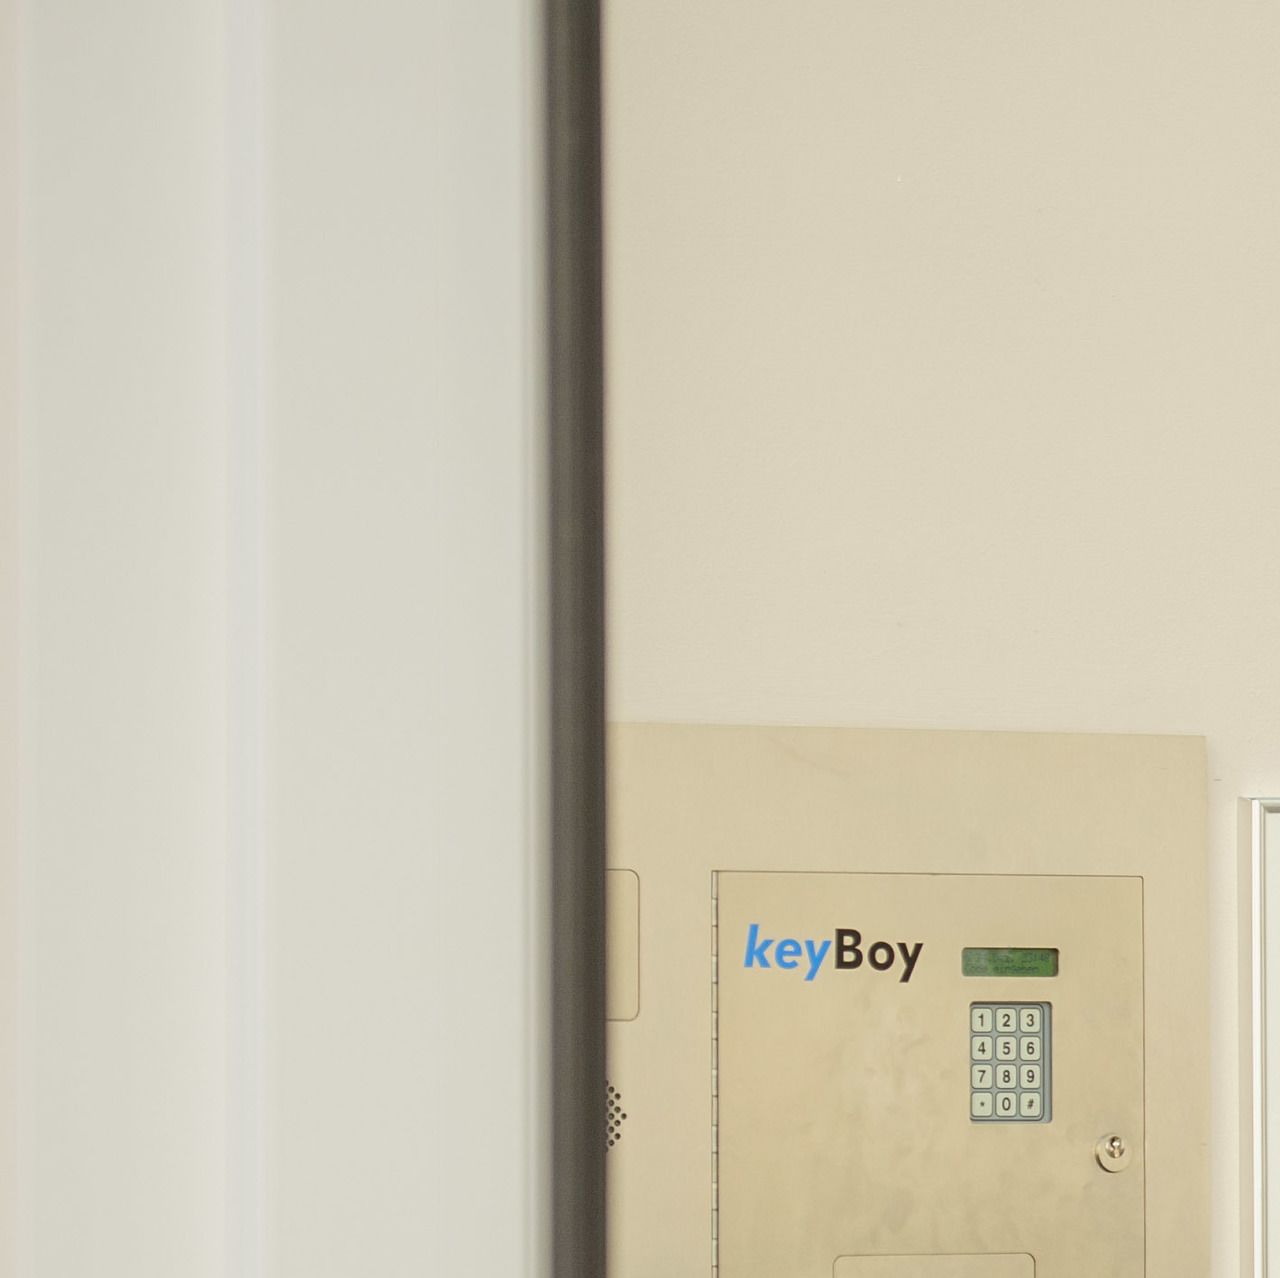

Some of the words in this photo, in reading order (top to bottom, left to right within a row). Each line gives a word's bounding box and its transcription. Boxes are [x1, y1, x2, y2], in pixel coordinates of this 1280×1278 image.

[745, 924, 924, 983] keyBoy
[978, 1013, 984, 1028] 1
[1002, 1013, 1011, 1028] 2
[1026, 1013, 1035, 1028] 3
[977, 1041, 987, 1055] 4
[1002, 1041, 1011, 1056] 5
[1026, 1041, 1035, 1056] 6
[977, 1069, 987, 1084] 7
[1002, 1069, 1011, 1084] 8
[1026, 1069, 1035, 1084] 9
[1001, 1097, 1012, 1112] 0
